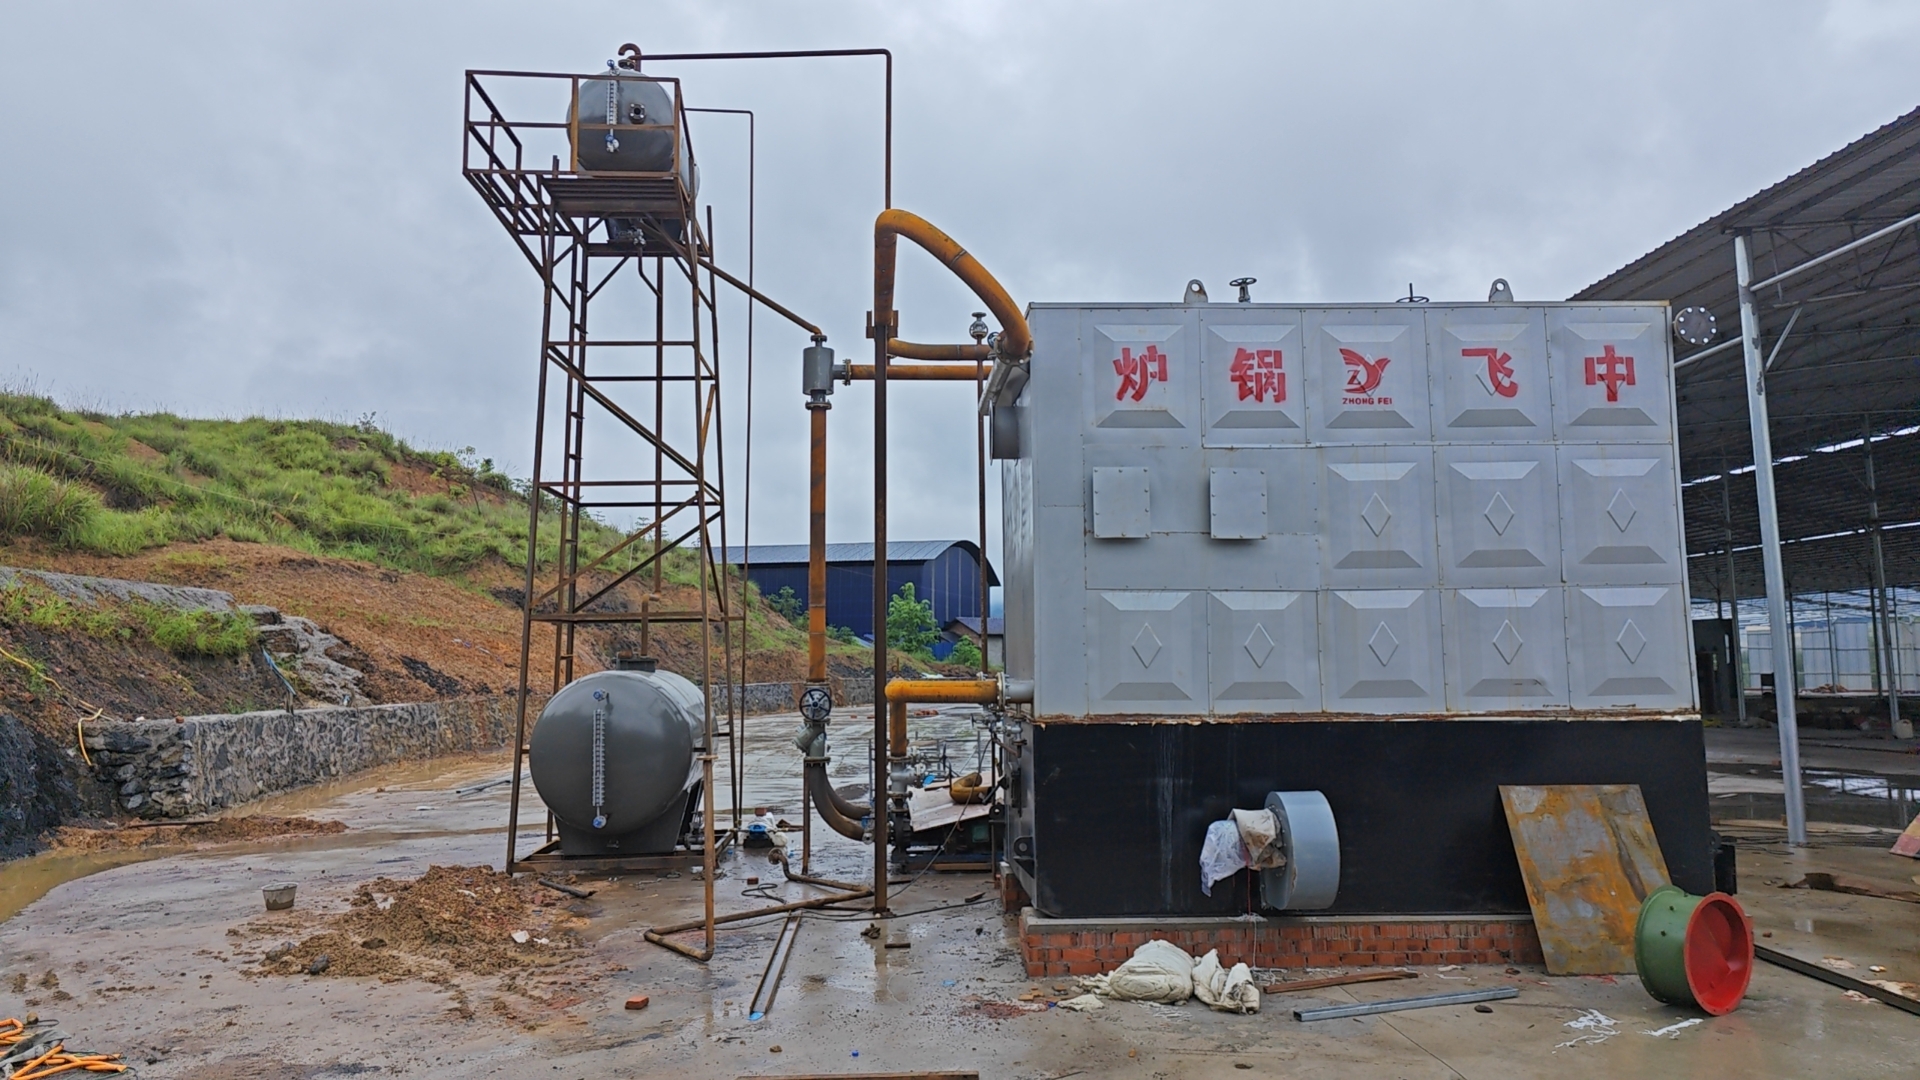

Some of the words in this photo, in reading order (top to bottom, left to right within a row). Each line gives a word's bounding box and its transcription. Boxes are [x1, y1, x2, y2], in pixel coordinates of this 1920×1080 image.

[1112, 344, 1169, 403] 炉
[1229, 347, 1287, 403] 锅
[1460, 346, 1519, 399] 飞
[1583, 344, 1637, 403] 中
[1342, 397, 1375, 405] ZHONG
[1377, 397, 1392, 405] FEI
